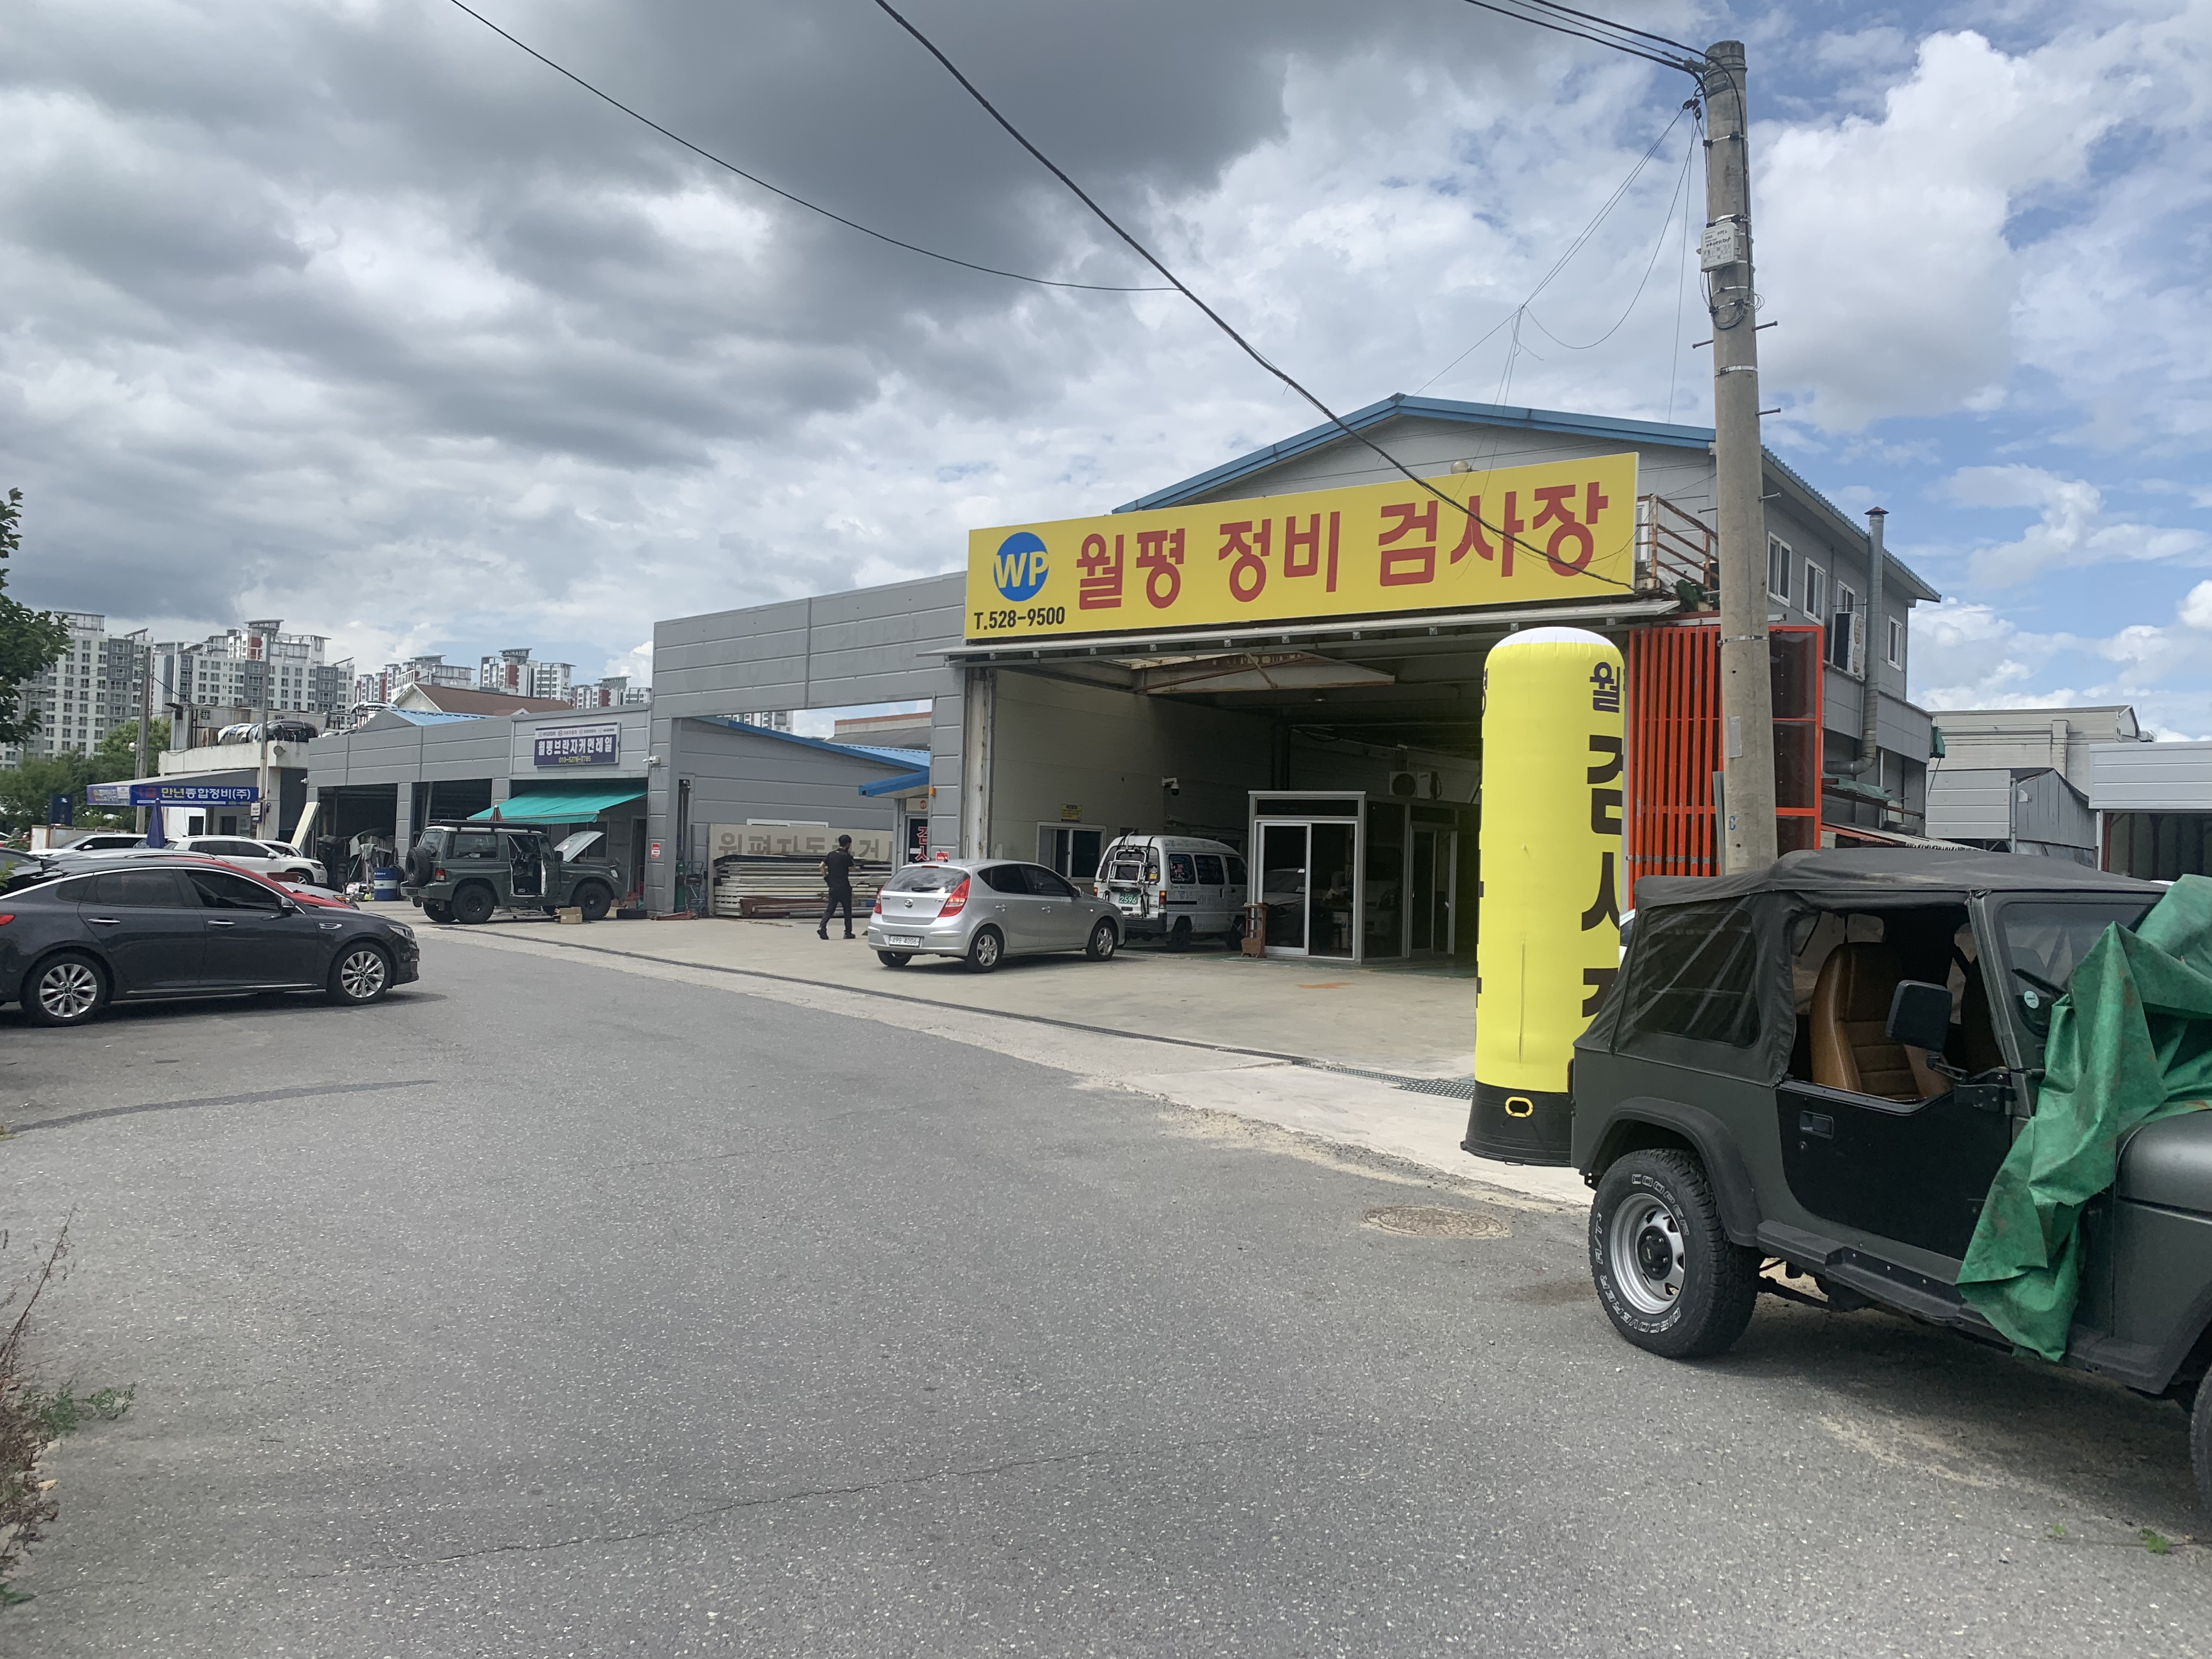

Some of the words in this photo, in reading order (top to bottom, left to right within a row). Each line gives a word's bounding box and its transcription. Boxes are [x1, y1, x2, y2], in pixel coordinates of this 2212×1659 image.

[994, 551, 1049, 589] WP
[1076, 529, 1184, 610] 월평
[1218, 512, 1339, 602] 정비
[1379, 483, 1608, 586] 검사장
[974, 607, 1065, 630] T.528-9500
[1119, 896, 1136, 904] 2596
[1632, 1174, 1690, 1235] COOPER
[1600, 1275, 1681, 1334] DISCOVERER
